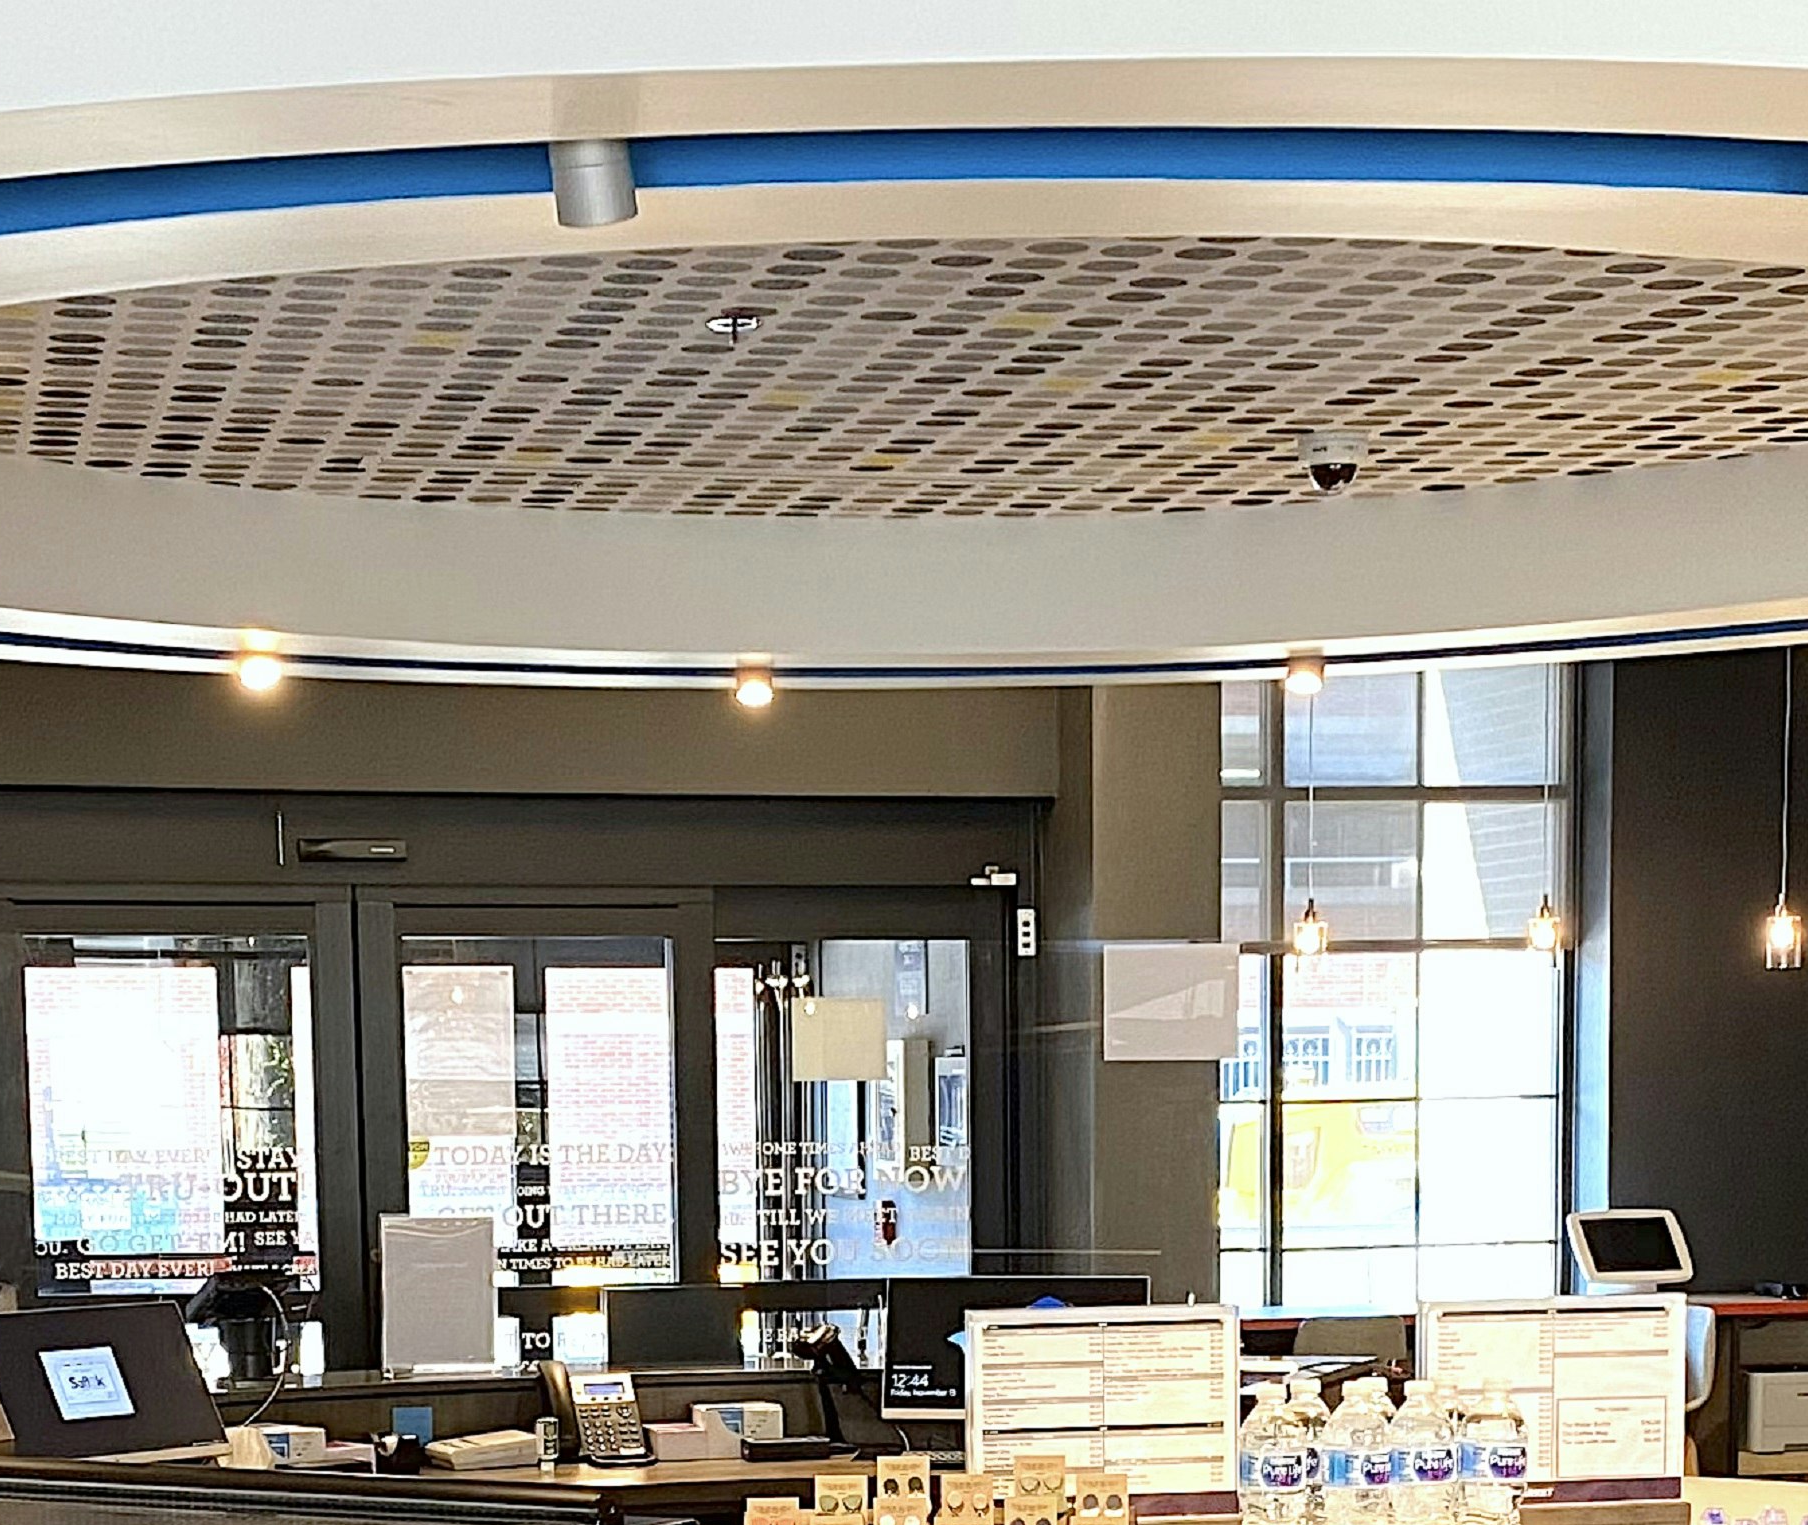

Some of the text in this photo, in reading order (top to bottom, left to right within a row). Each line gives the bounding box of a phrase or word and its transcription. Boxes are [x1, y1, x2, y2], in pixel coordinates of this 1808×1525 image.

[434, 1142, 668, 1167] TODAY IS THE DAY
[720, 1164, 967, 1196] BYE FOR NOW
[571, 1203, 668, 1226] THERE
[757, 1208, 800, 1227] TILL
[34, 1240, 69, 1256] OU.
[720, 1242, 781, 1267] SEE
[786, 1239, 858, 1267] YOU
[54, 1262, 106, 1281] BEST
[109, 1262, 155, 1280] DAY
[508, 1257, 554, 1271] TIMES
